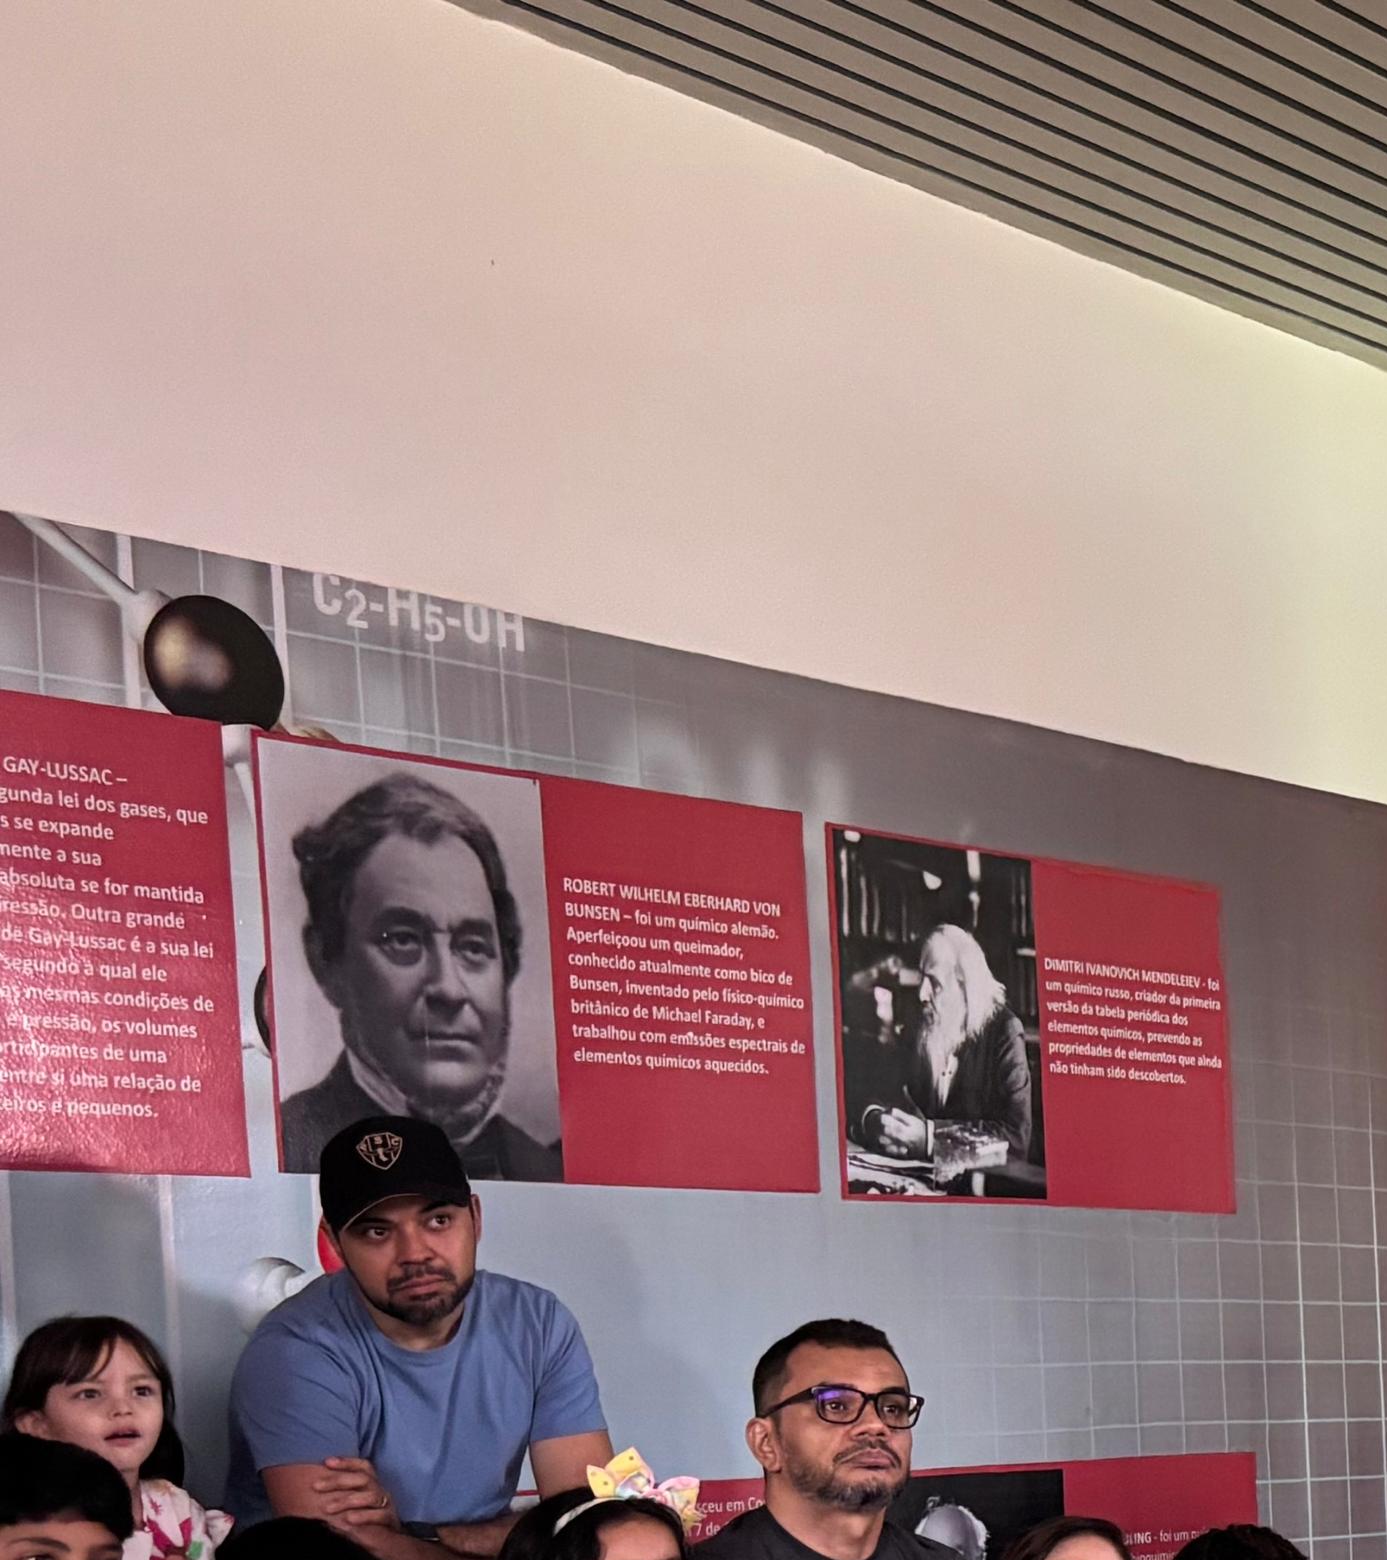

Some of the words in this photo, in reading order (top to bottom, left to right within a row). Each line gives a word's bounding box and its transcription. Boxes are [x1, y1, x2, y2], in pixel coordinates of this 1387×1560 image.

[3, 756, 113, 785] GAY-LUSSAC
[58, 791, 79, 808] lei
[85, 795, 115, 813] dos
[120, 802, 171, 822] gases,
[177, 808, 208, 826] que
[14, 817, 33, 830] se
[38, 820, 114, 840] expande
[72, 851, 102, 866] sua
[0, 868, 75, 891] absoluta
[81, 879, 99, 892] se
[104, 878, 129, 896] for
[134, 885, 204, 904] mantida
[563, 877, 616, 896] ROBERT
[620, 885, 680, 905] WILHELM
[684, 893, 749, 913] EBERHARD
[753, 902, 780, 917] VON
[72, 904, 120, 923] Outra
[127, 912, 185, 929] grande
[565, 902, 620, 922] BUNSEN
[635, 910, 651, 925] foi
[679, 917, 727, 936] químico
[731, 923, 779, 940] alemão.
[161, 942, 188, 956] sua
[194, 941, 213, 959] lei
[567, 927, 646, 949] Aperfeiçoou
[674, 941, 744, 960] queimador,
[100, 963, 136, 981] qual
[142, 965, 167, 981] ele
[569, 952, 635, 970] conhecido
[639, 959, 711, 978] atualmente
[714, 968, 747, 981] como
[750, 969, 774, 984] bico
[1044, 958, 1084, 972] DIMITRI
[1086, 963, 1139, 981] IVANOVICH
[1142, 970, 1199, 988] MENDELEIEV
[1208, 978, 1219, 991] foi
[104, 990, 188, 1012] condições
[194, 996, 214, 1012] de
[570, 975, 622, 995] Bunsen,
[626, 980, 689, 999] inventado
[693, 988, 719, 1003] pelo
[1064, 982, 1102, 996] químico
[1135, 990, 1166, 1004] criador
[1183, 997, 1220, 1010] primeira
[571, 999, 629, 1017] britânico
[652, 1006, 701, 1023] Michael
[705, 1011, 755, 1030] Faraday,
[1047, 1001, 1079, 1013] versão
[1096, 1004, 1125, 1019] tabela
[1128, 1008, 1169, 1023] periódica
[1172, 1014, 1188, 1026] dos
[102, 1020, 120, 1033] os
[125, 1020, 197, 1038] volumes
[573, 1024, 636, 1041] trabalhou
[640, 1031, 666, 1043] com
[670, 1032, 725, 1048] emissões
[729, 1038, 787, 1054] espectrais
[1048, 1020, 1098, 1036] elementos
[1147, 1032, 1190, 1046] prevendo
[103, 1044, 124, 1060] de
[129, 1050, 167, 1064] uma
[574, 1048, 641, 1065] elementos
[646, 1054, 700, 1070] químicos
[705, 1059, 769, 1074] aquecidos.
[1049, 1042, 1112, 1057] propriedades
[1129, 1048, 1176, 1064] elementos
[1198, 1054, 1222, 1068] ainda
[113, 1073, 176, 1093] relação
[181, 1075, 201, 1092] de
[1050, 1061, 1067, 1073] não
[1071, 1063, 1104, 1077] tinham
[1107, 1066, 1125, 1078] sido
[1129, 1067, 1186, 1084] descobertos.
[727, 1501, 744, 1511] em
